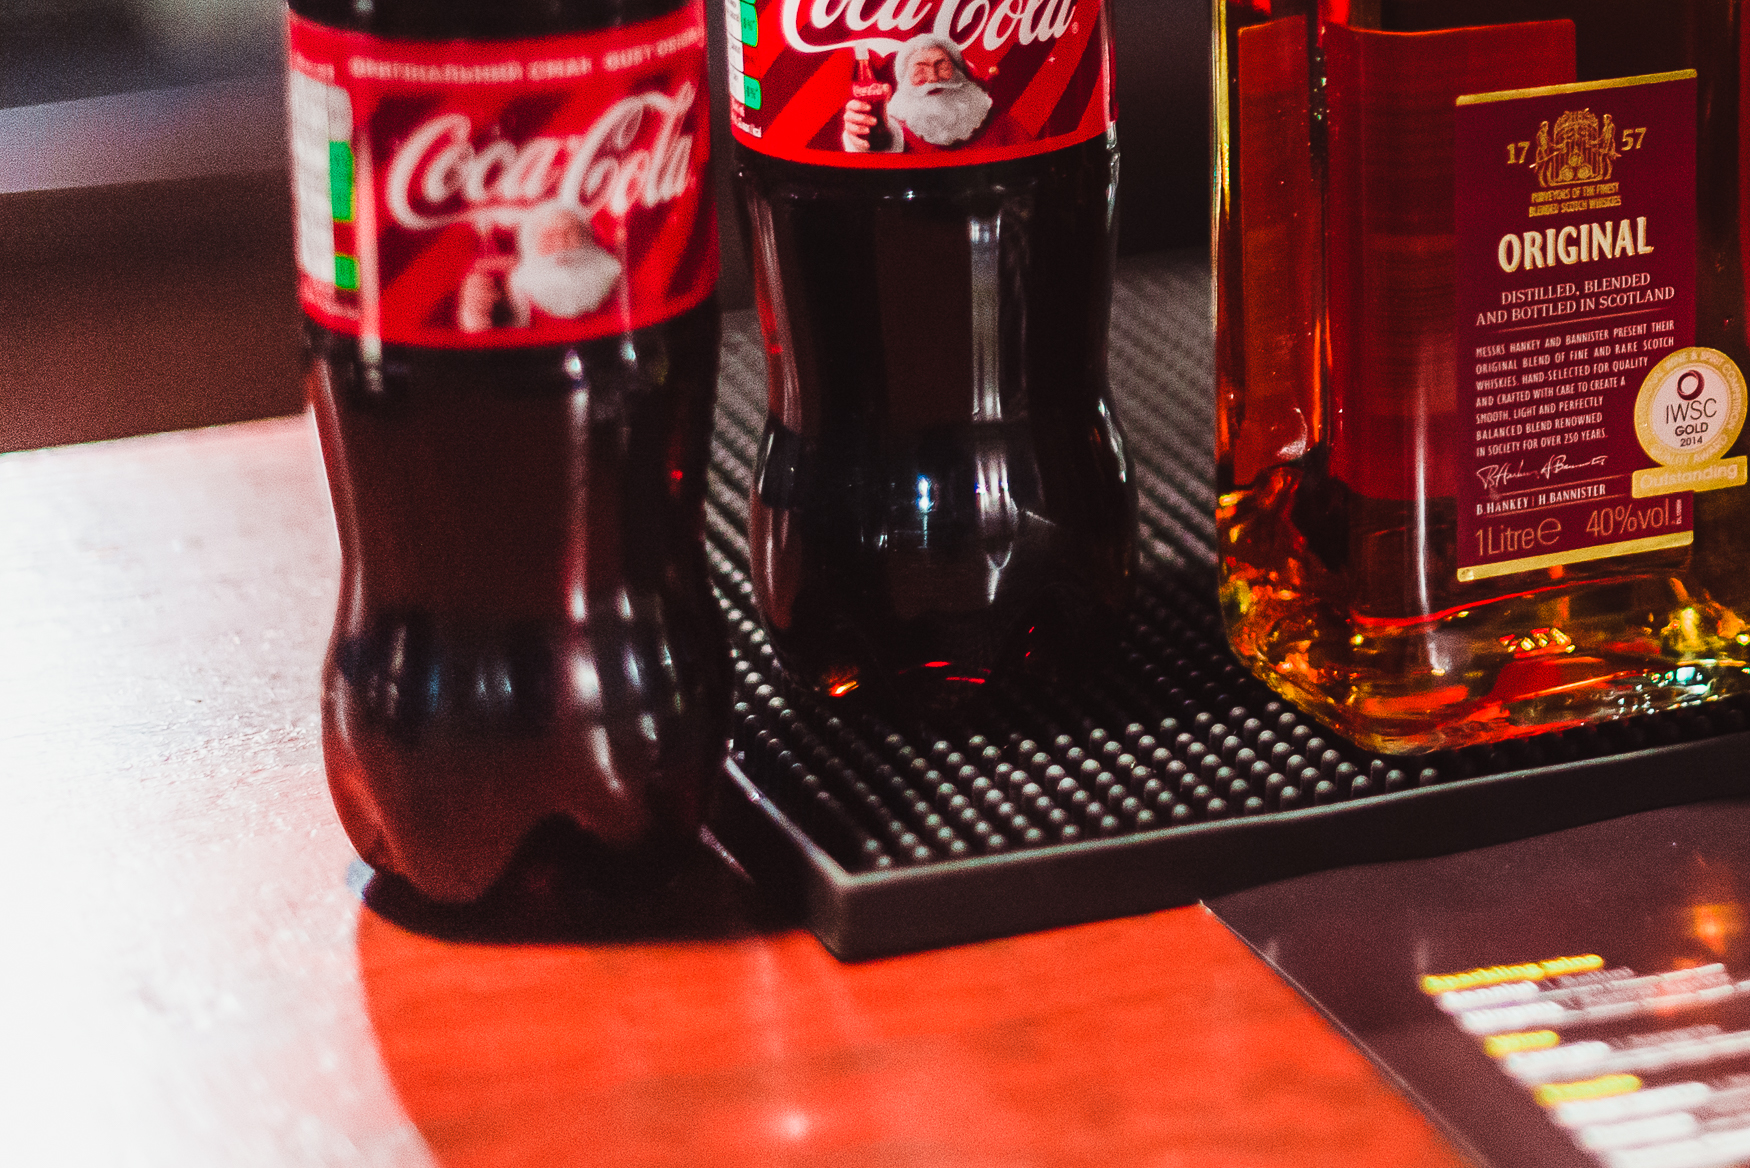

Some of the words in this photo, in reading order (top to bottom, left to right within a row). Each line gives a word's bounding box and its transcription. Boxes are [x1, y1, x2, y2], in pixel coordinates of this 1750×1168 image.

[386, 81, 698, 231] Coca-Cola
[1506, 142, 1531, 165] 17
[1621, 127, 1647, 151] 57
[1498, 216, 1654, 273] ORIGINAL
[1501, 282, 1581, 305] DISTILLED,
[1584, 272, 1651, 294] BLENDED
[1476, 310, 1508, 326] AND
[1511, 300, 1577, 322] BOTTLED
[1580, 298, 1596, 312] IN
[1599, 286, 1675, 309] SCOTLAND
[1475, 343, 1506, 359] MESSRS
[1510, 339, 1541, 354] HANKEY
[1544, 336, 1562, 349] AND
[1565, 329, 1609, 345] BANNISTER
[1613, 323, 1647, 338] PRESENT
[1651, 320, 1675, 333] THEIR
[1475, 359, 1518, 375] ORIGINAL
[1522, 354, 1551, 369] BLEND
[1554, 351, 1566, 363] OF
[1569, 348, 1589, 361] FINE
[1593, 345, 1611, 358] AND
[1615, 341, 1638, 355] RARE
[1643, 336, 1675, 351] SCOTCH
[1522, 364, 1591, 385] HAND-SELECTED
[1593, 360, 1610, 374] FOR
[1612, 355, 1649, 372] QUALITY
[1476, 396, 1494, 408] AND
[1497, 389, 1531, 405] CRAFTED
[1533, 386, 1554, 400] WITH
[1556, 382, 1576, 396] CARE
[1578, 380, 1589, 393] TO
[1590, 377, 1619, 392] CREATE
[1620, 375, 1627, 387] A
[1513, 406, 1537, 419] LIGHT
[1538, 402, 1557, 415] AND
[1559, 395, 1604, 412] PERFECTLY
[1476, 424, 1523, 441] BALANCED
[1525, 420, 1553, 434] BLEND
[1554, 412, 1603, 429] RENOWNED
[1665, 397, 1718, 425] IWSC
[1476, 447, 1486, 458] IN
[1488, 441, 1521, 456] SOCIETY
[1522, 438, 1539, 450] FOR
[1540, 434, 1562, 448] OVER
[1564, 432, 1579, 444] 250
[1674, 422, 1709, 437] GOLD
[1680, 436, 1703, 448] 2014
[1639, 463, 1739, 489] Outstanding
